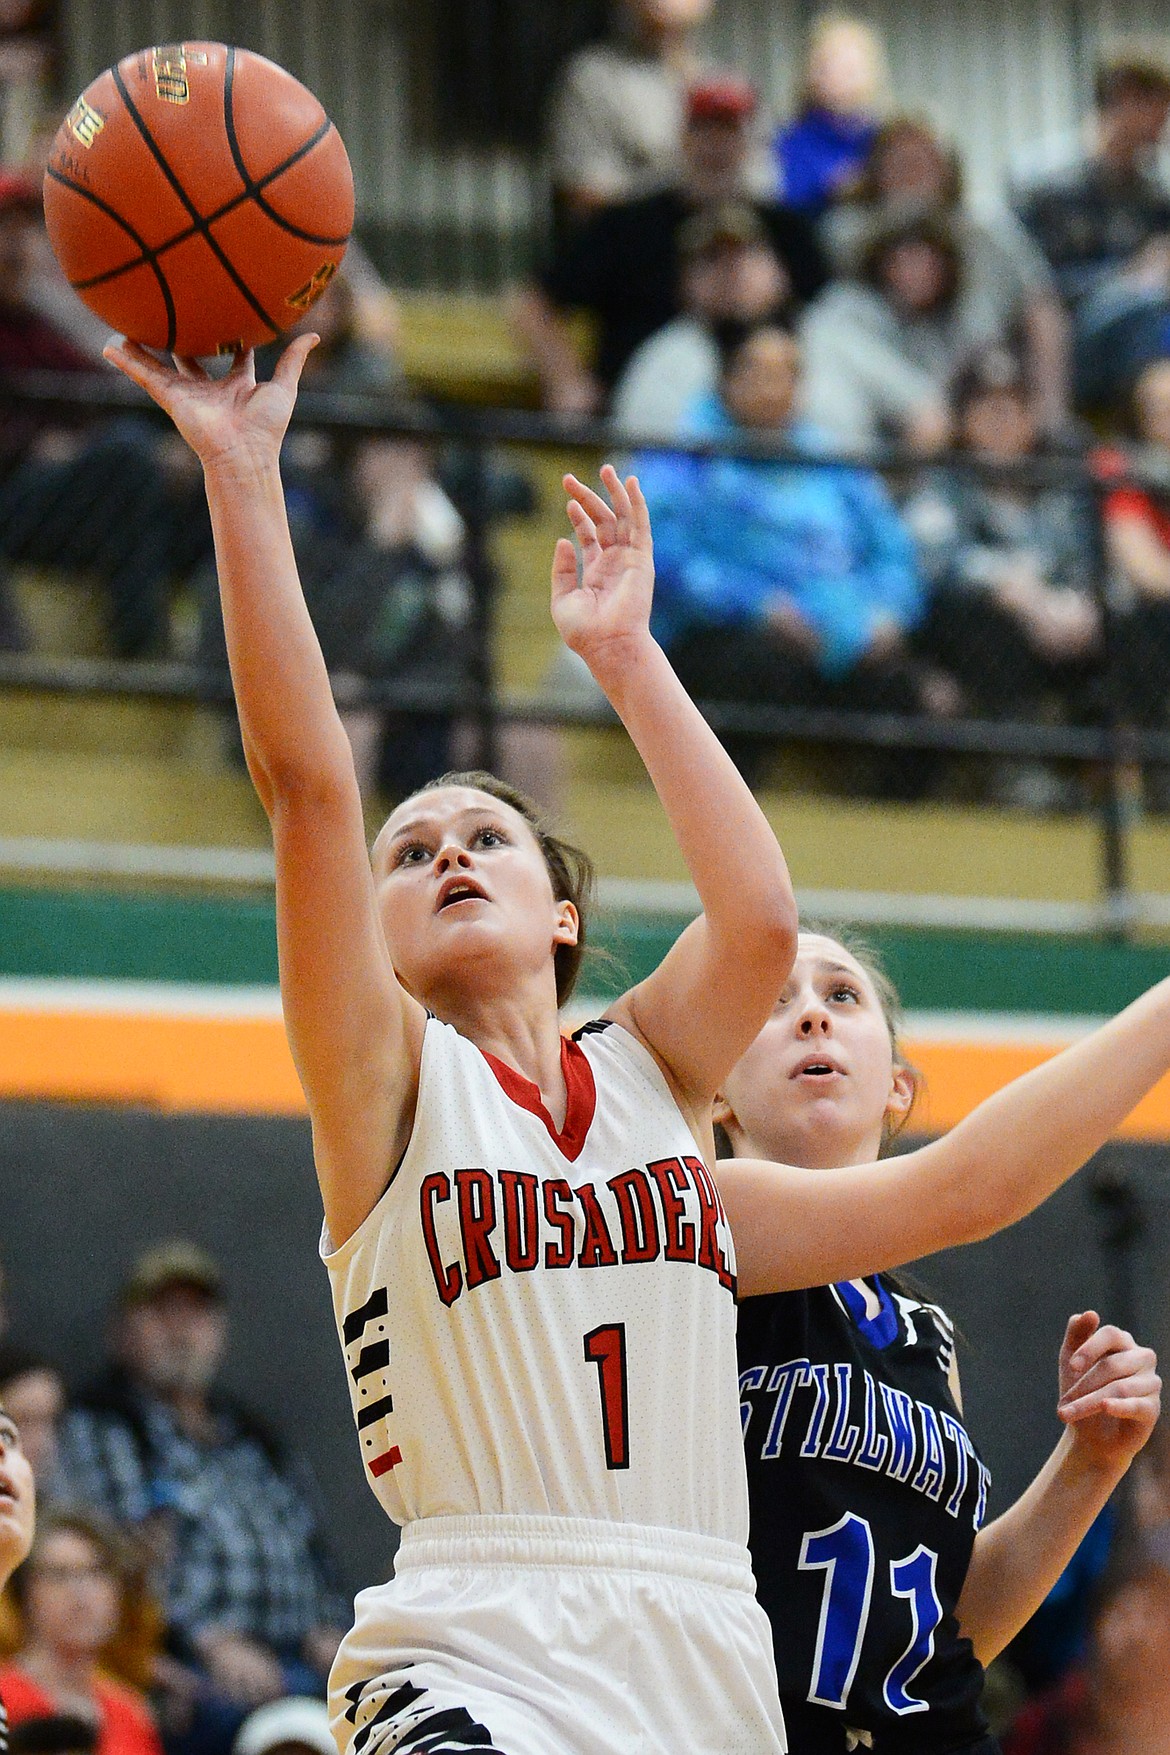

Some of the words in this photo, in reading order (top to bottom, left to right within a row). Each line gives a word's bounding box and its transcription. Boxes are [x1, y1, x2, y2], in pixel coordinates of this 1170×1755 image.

[420, 1155, 738, 1308] CRUSADER
[583, 1322, 630, 1470] 1
[797, 1511, 941, 1716] 11
